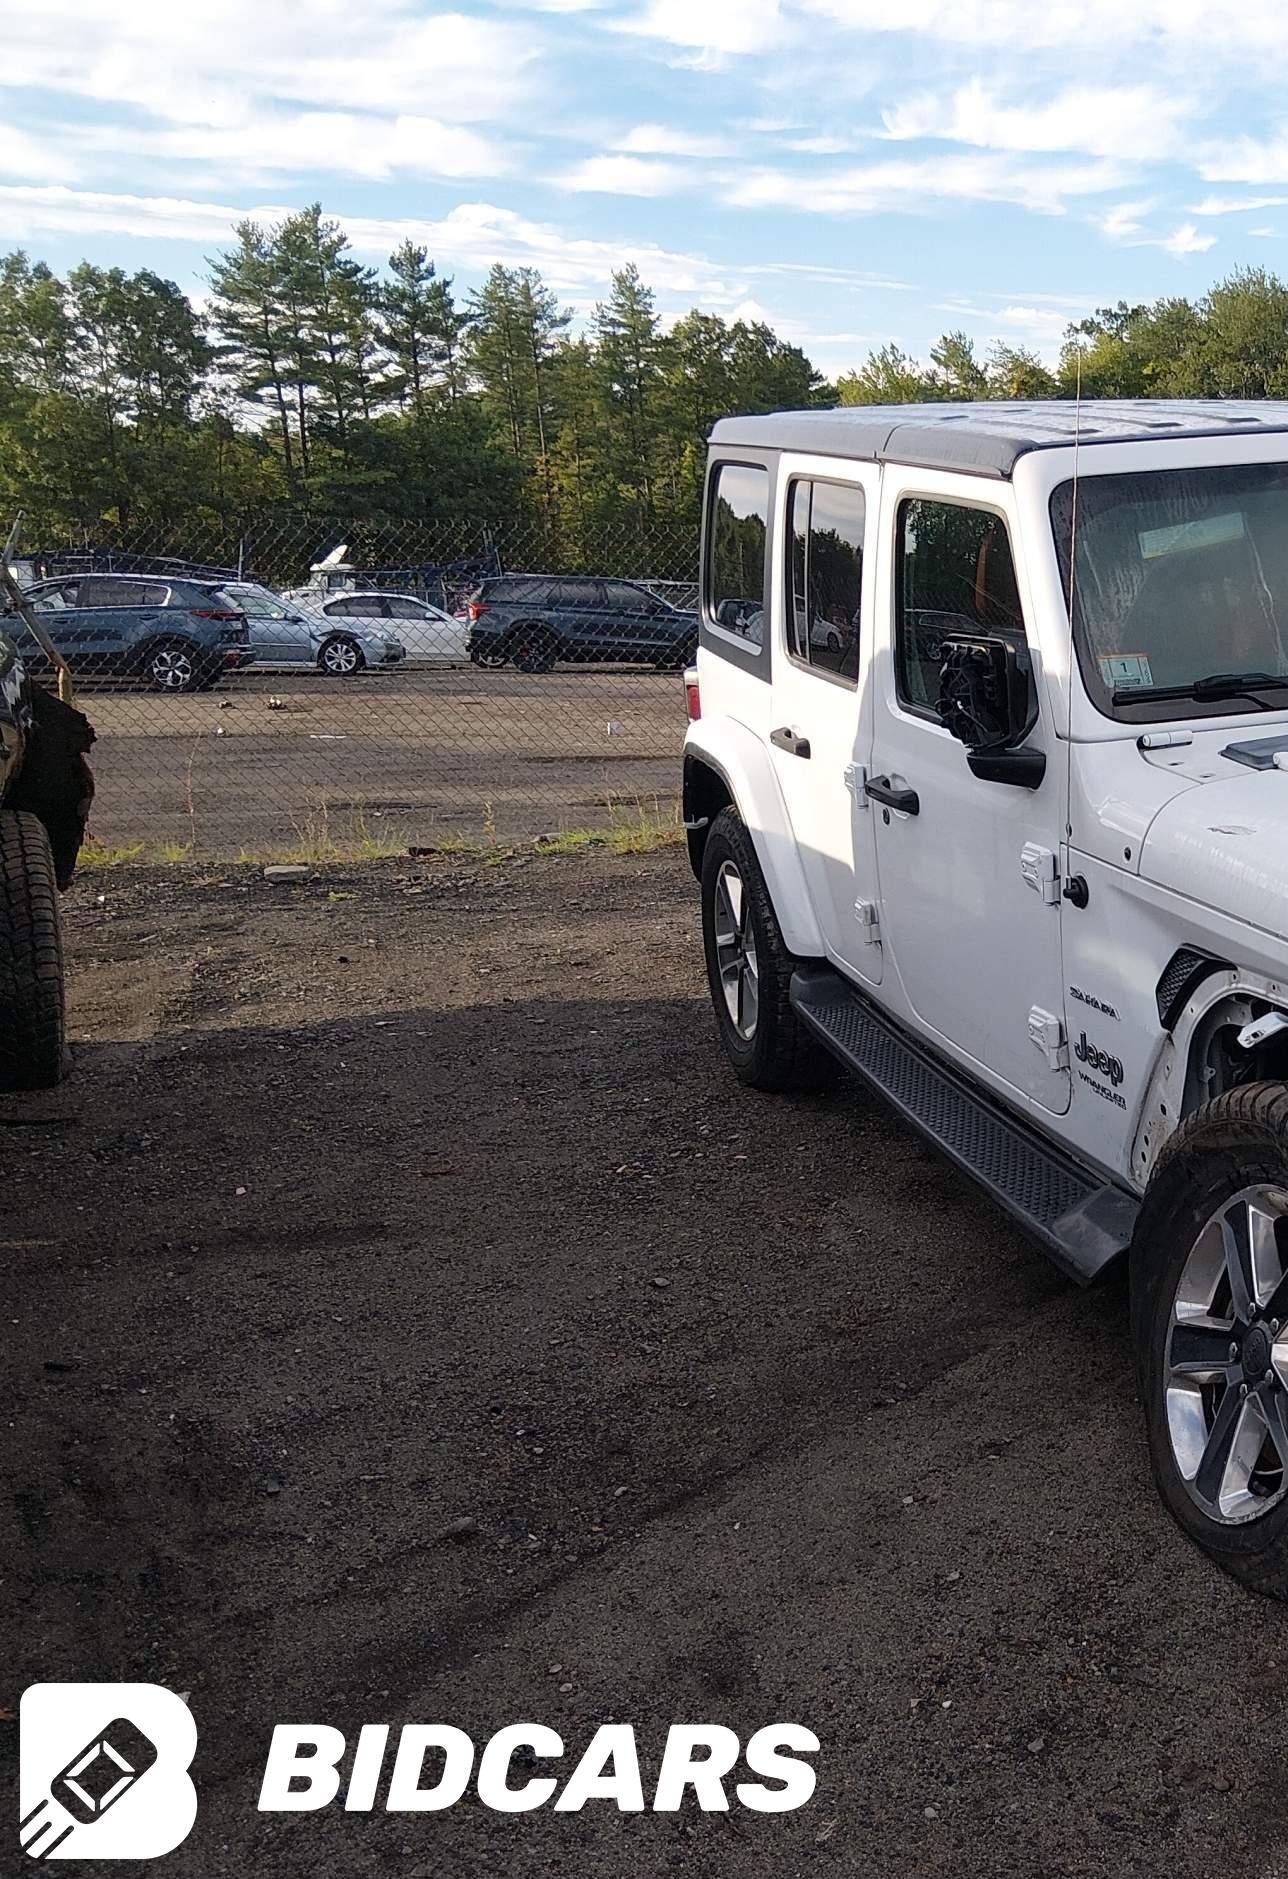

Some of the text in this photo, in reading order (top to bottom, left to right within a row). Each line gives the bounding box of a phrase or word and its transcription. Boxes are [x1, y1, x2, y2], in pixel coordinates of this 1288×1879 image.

[1120, 662, 1127, 672] 1
[1069, 986, 1120, 1021] SAHARA
[1074, 1031, 1124, 1087] Jeep
[1078, 1070, 1126, 1104] WRANGLER
